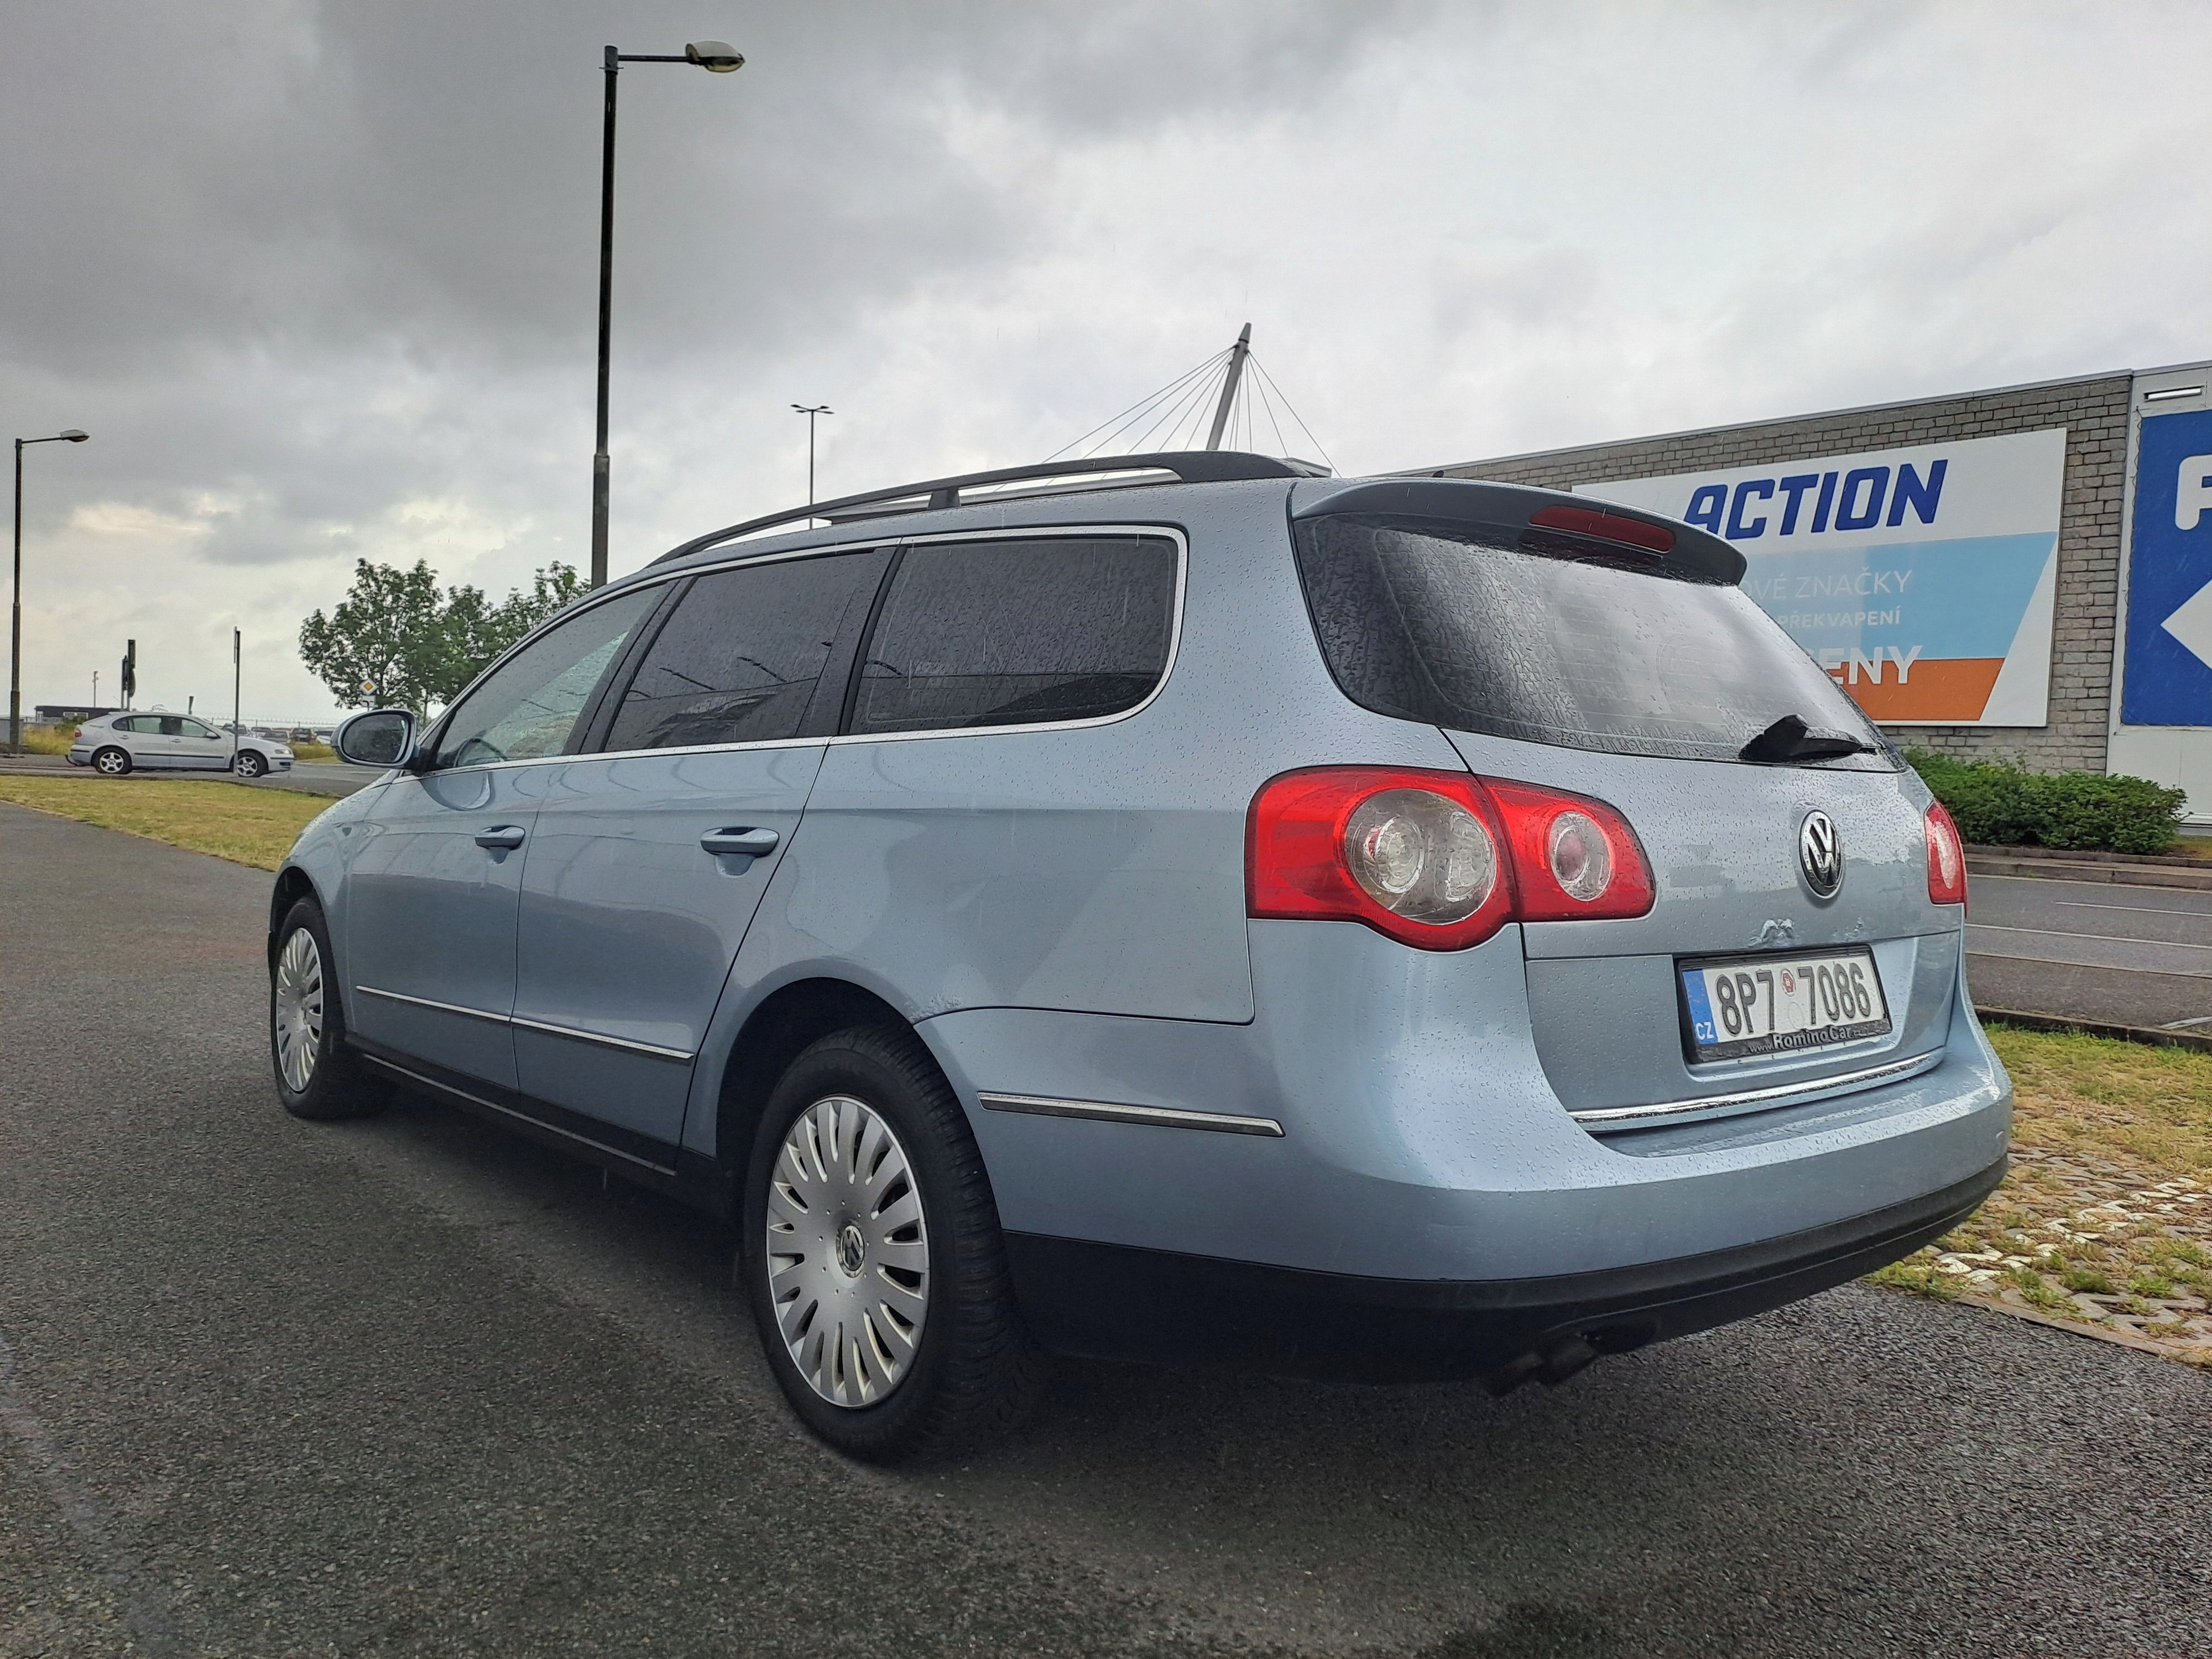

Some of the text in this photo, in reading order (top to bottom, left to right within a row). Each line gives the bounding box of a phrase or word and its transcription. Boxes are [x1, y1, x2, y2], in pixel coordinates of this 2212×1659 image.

[1683, 459, 1948, 540] ACTION
[1795, 566, 1912, 598] ZNAČKY
[1778, 605, 1901, 628] PŘEKVAPENÍ
[1805, 645, 1923, 685] ENY
[1717, 963, 1871, 1035] 8P7 7086
[1695, 1021, 1714, 1040] CZ
